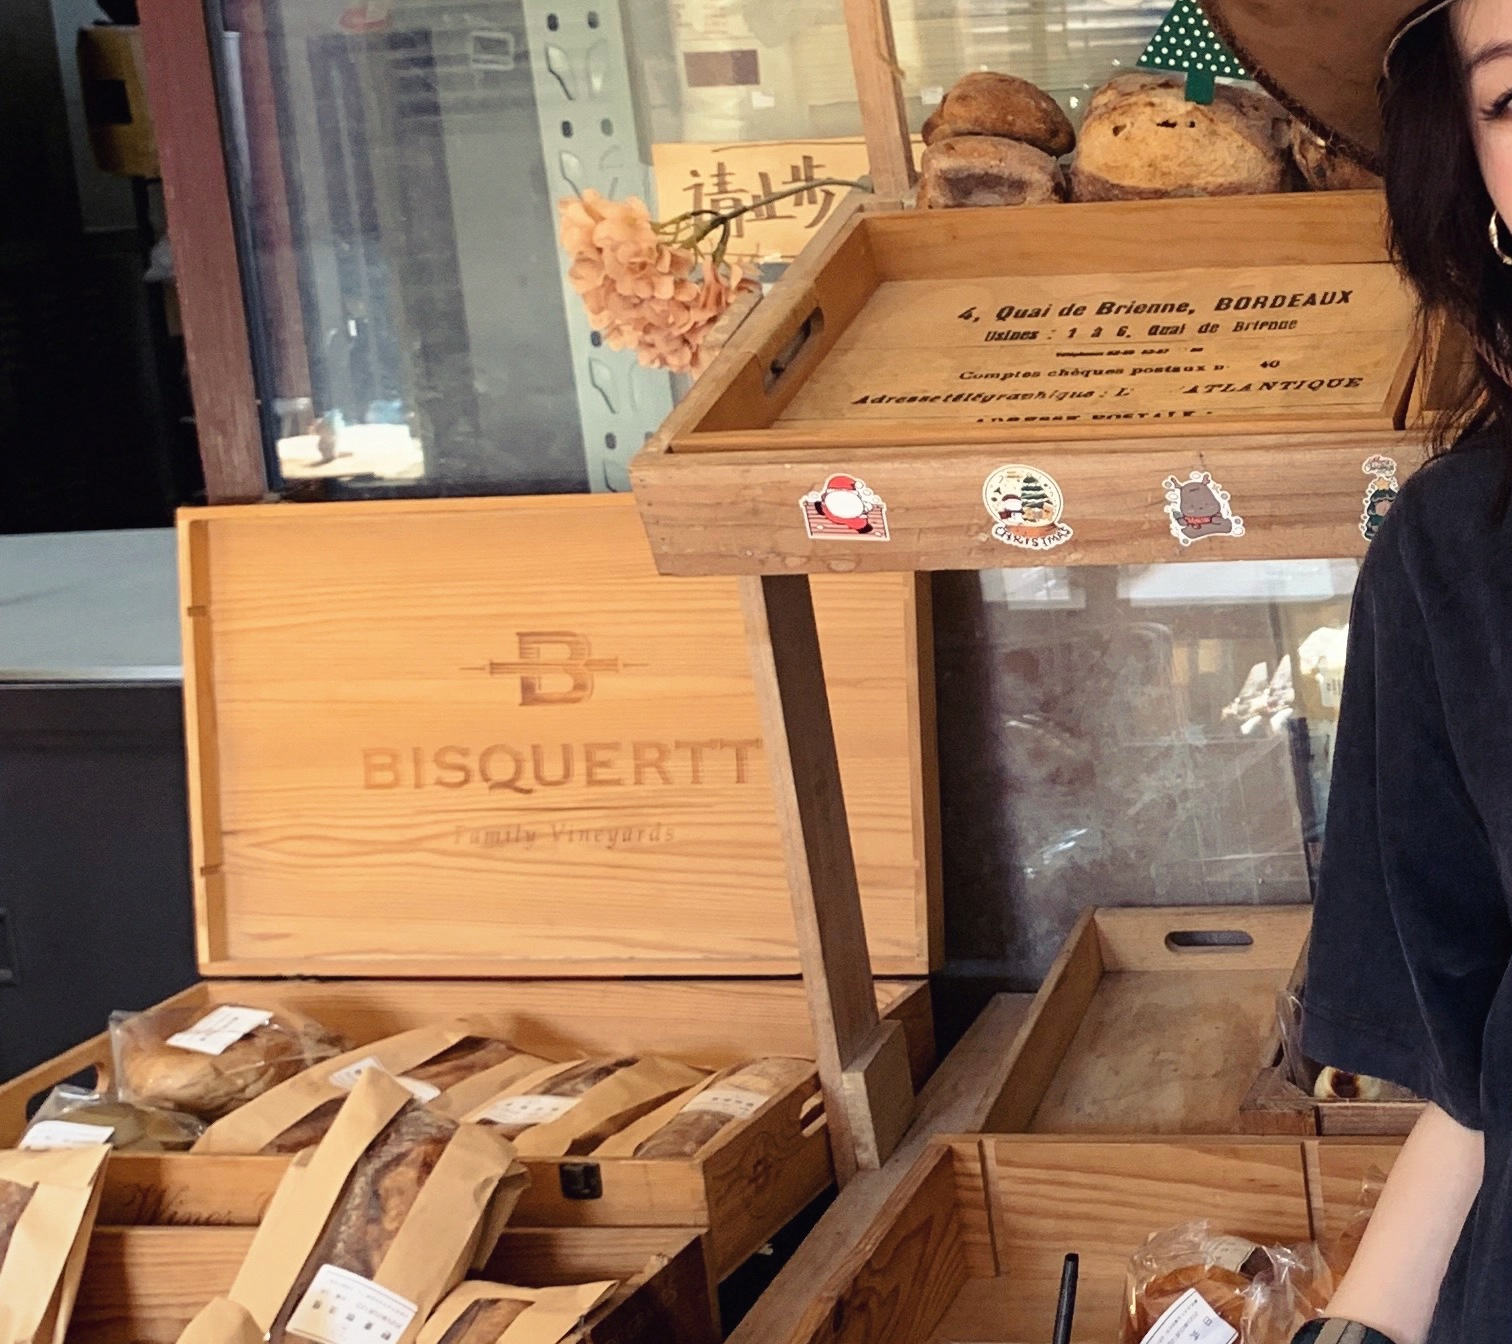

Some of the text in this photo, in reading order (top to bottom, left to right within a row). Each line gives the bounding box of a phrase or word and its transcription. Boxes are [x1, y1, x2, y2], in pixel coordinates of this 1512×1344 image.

[996, 302, 1052, 321] Quai
[1059, 301, 1087, 317] de
[1214, 290, 1353, 311] BORDEAUX
[361, 736, 764, 795] BISQUERTT
